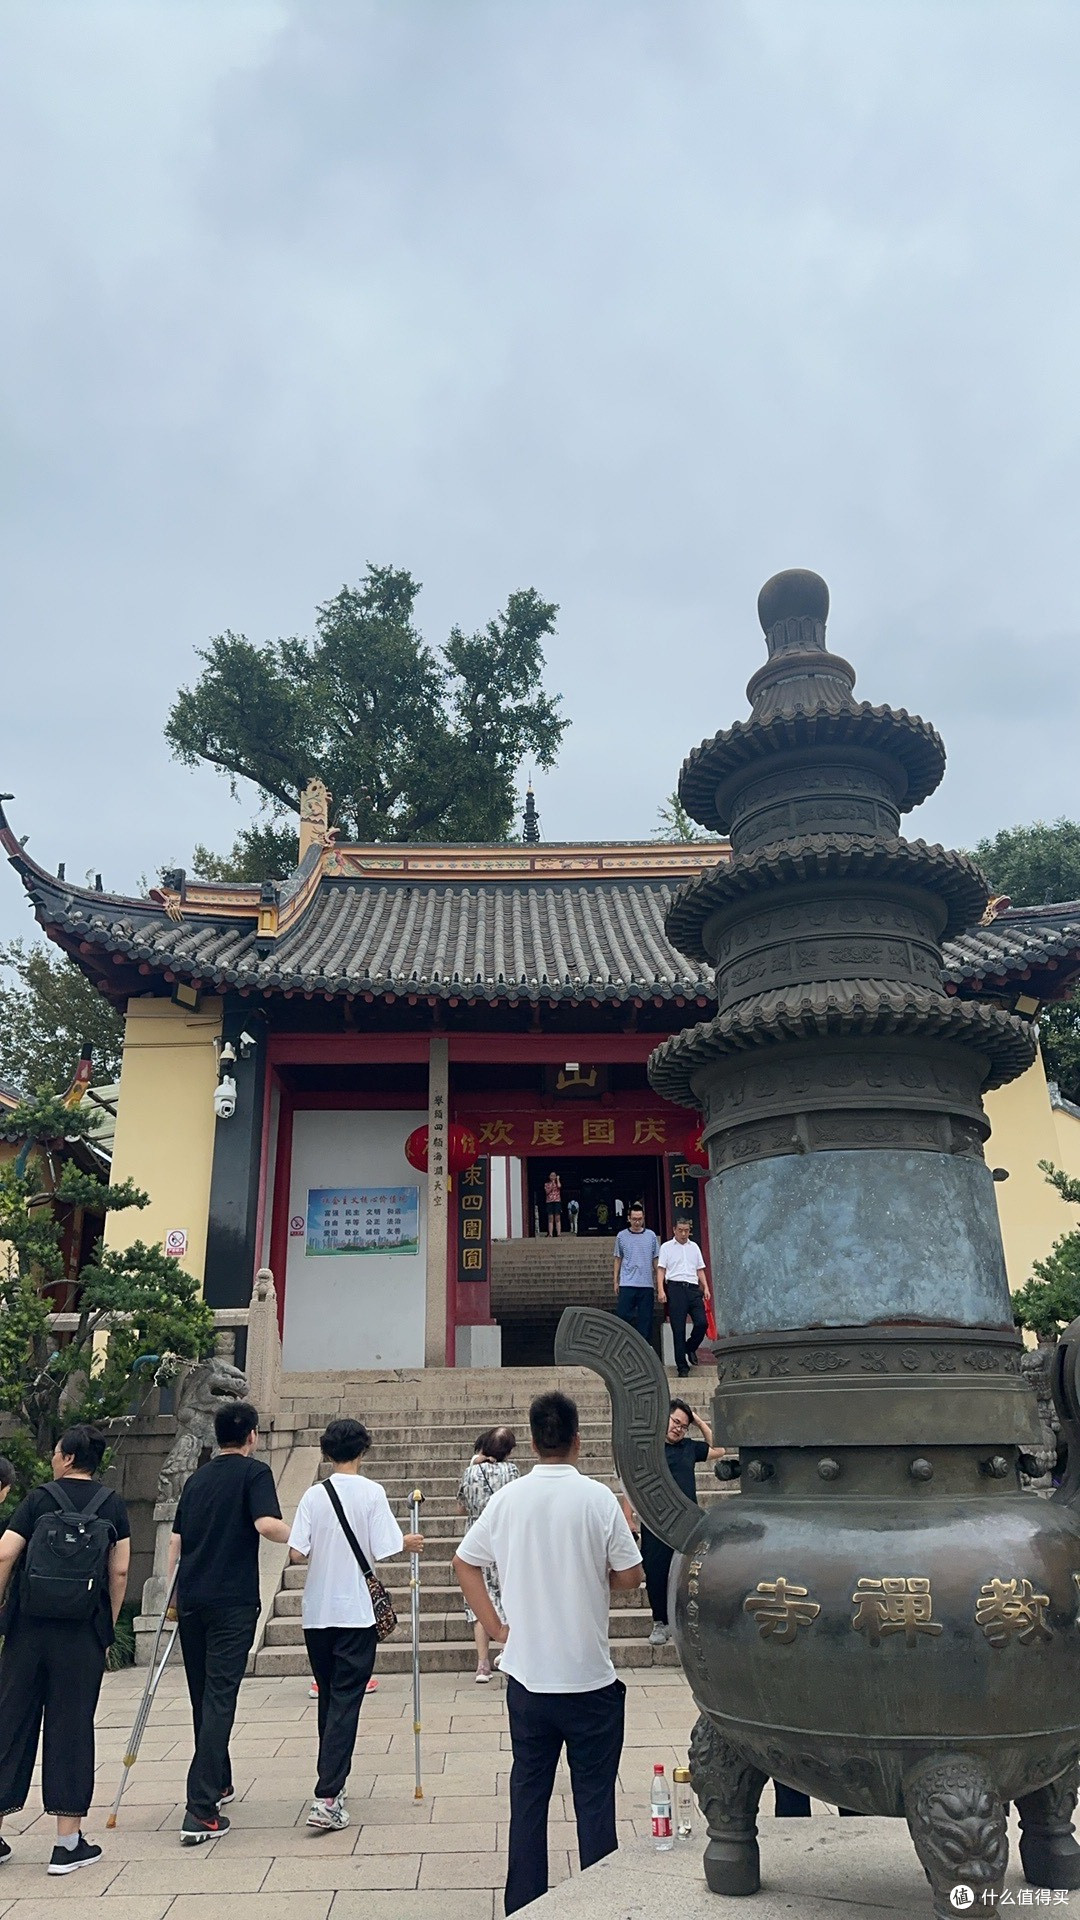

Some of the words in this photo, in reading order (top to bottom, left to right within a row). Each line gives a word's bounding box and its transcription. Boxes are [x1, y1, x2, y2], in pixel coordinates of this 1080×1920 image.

[556, 1068, 597, 1089] 山
[479, 1118, 667, 1146] 欢度国庆
[324, 1209, 339, 1217] 富强
[366, 1208, 381, 1216] 文明
[323, 1229, 338, 1237] 爱国
[366, 1228, 380, 1236] 诚信
